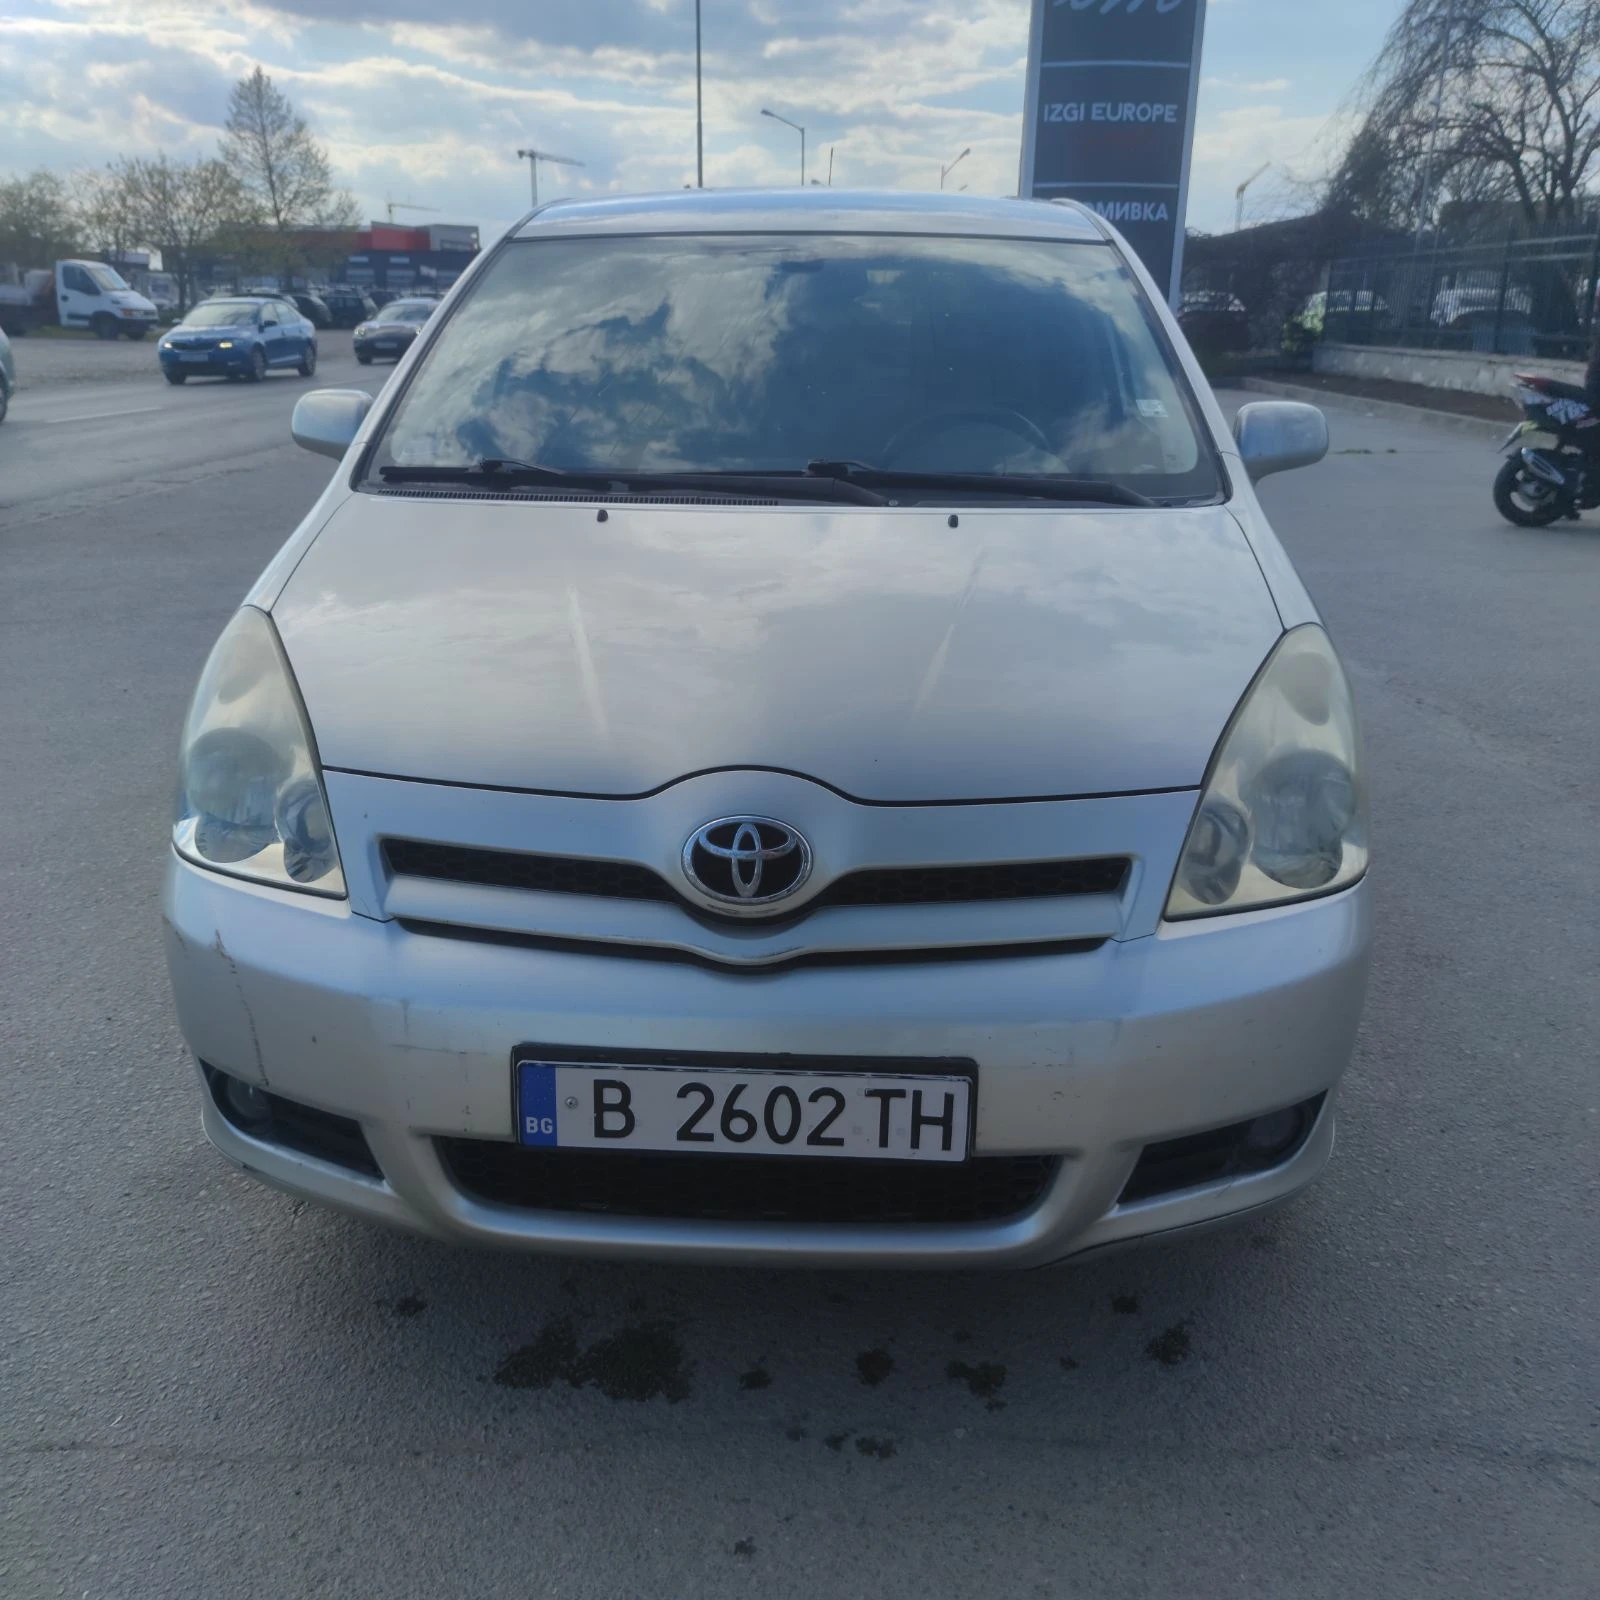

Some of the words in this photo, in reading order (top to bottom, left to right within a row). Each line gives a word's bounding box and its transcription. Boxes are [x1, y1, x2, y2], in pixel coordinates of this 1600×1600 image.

[1043, 102, 1084, 123] IZGI
[1090, 102, 1178, 123] EUROPE
[526, 1116, 553, 1135] BG
[593, 1078, 636, 1139] B
[676, 1082, 846, 1147] 2602
[865, 1087, 955, 1152] TH
